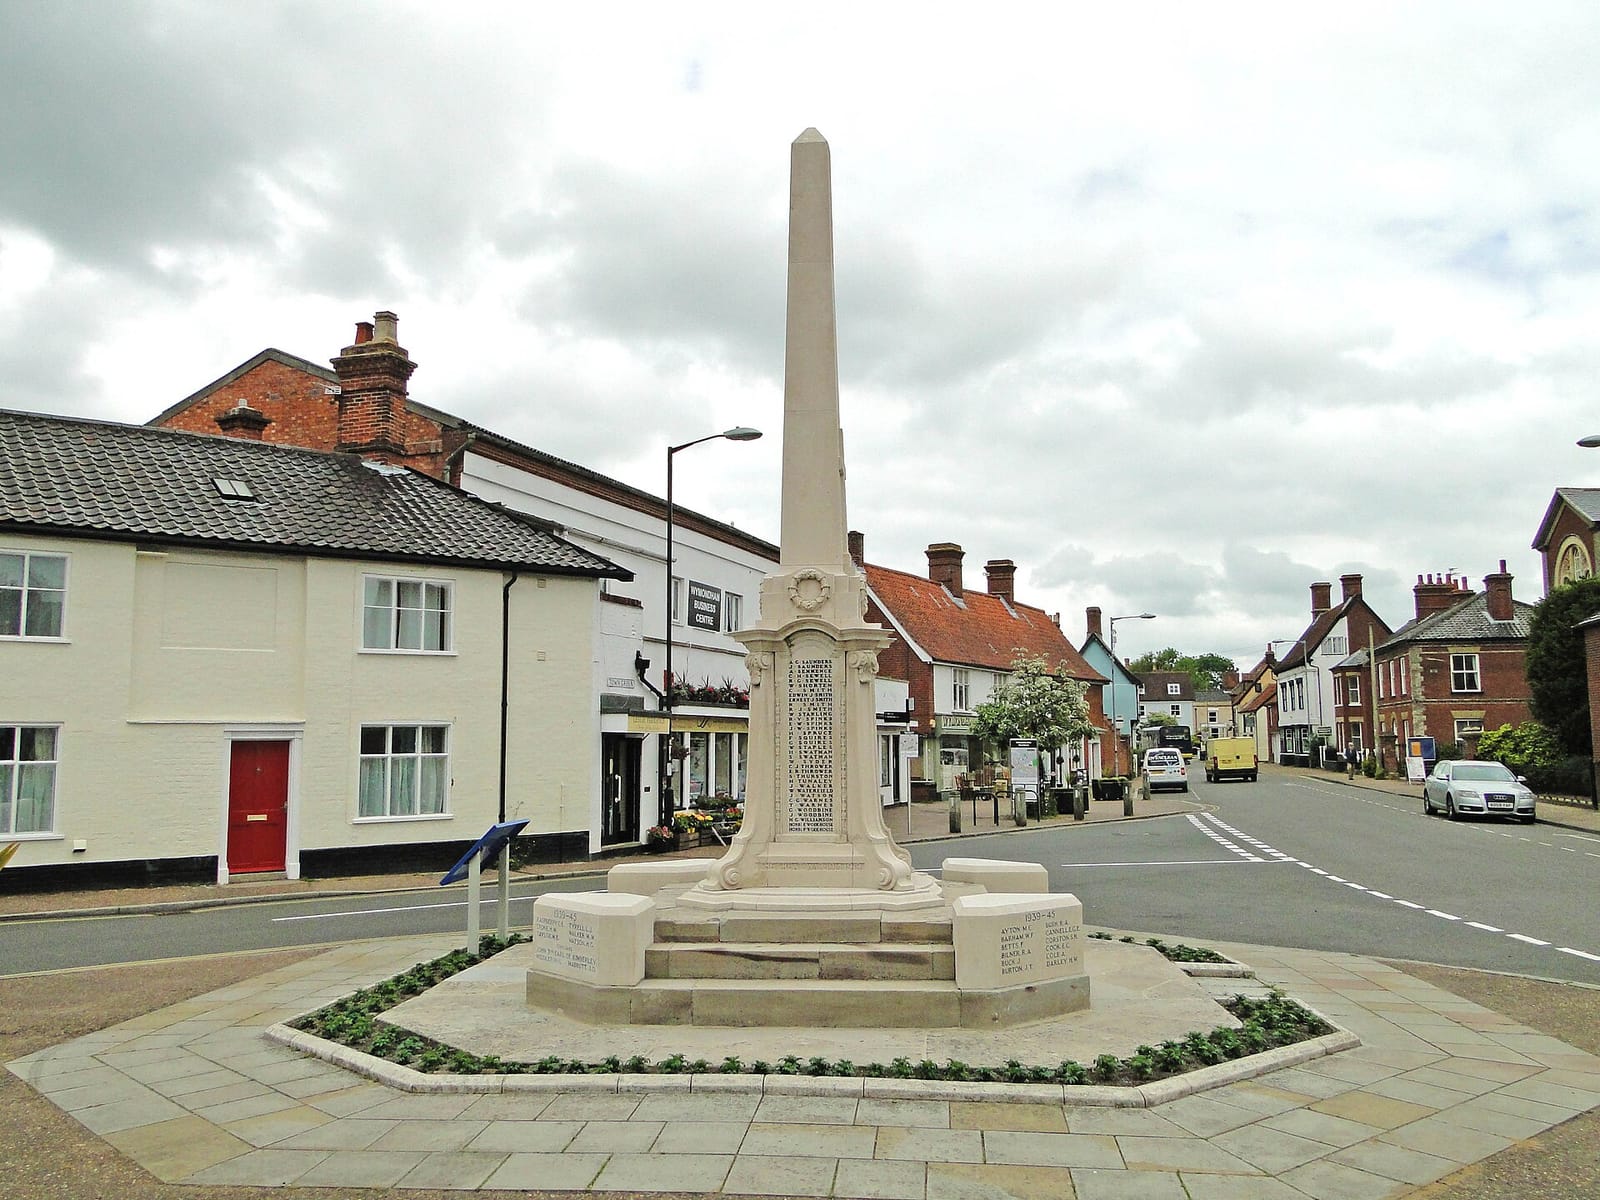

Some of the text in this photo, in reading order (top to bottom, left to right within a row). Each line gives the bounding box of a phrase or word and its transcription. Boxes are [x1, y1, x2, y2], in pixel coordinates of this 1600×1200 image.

[694, 600, 716, 614] BUSINESS
[695, 613, 714, 626] CENTRE
[1025, 910, 1056, 922] 1939-45
[1047, 959, 1066, 967] DARLEY
